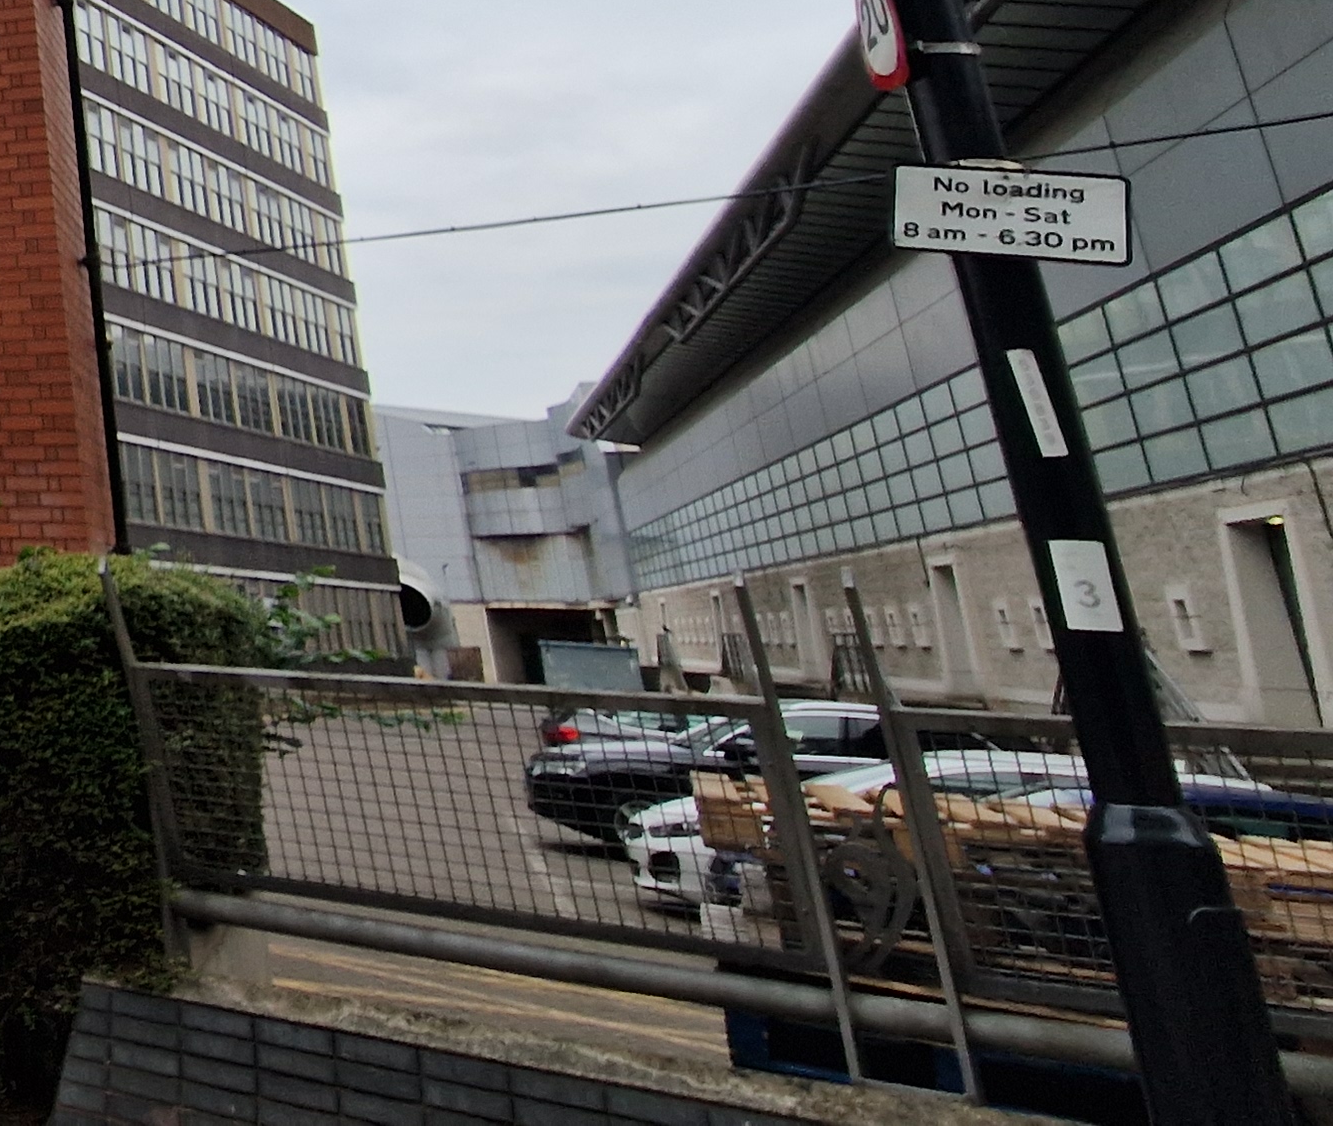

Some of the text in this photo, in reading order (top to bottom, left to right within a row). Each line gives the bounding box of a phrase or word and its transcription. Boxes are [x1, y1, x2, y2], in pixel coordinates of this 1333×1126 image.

[933, 176, 1085, 203] No loading
[941, 202, 997, 220] Mon
[1024, 207, 1071, 225] Sat
[903, 222, 920, 238] 8
[927, 227, 966, 241] am
[998, 229, 1064, 248] 6.30
[1072, 236, 1115, 253] pm
[1074, 579, 1101, 608] 3
